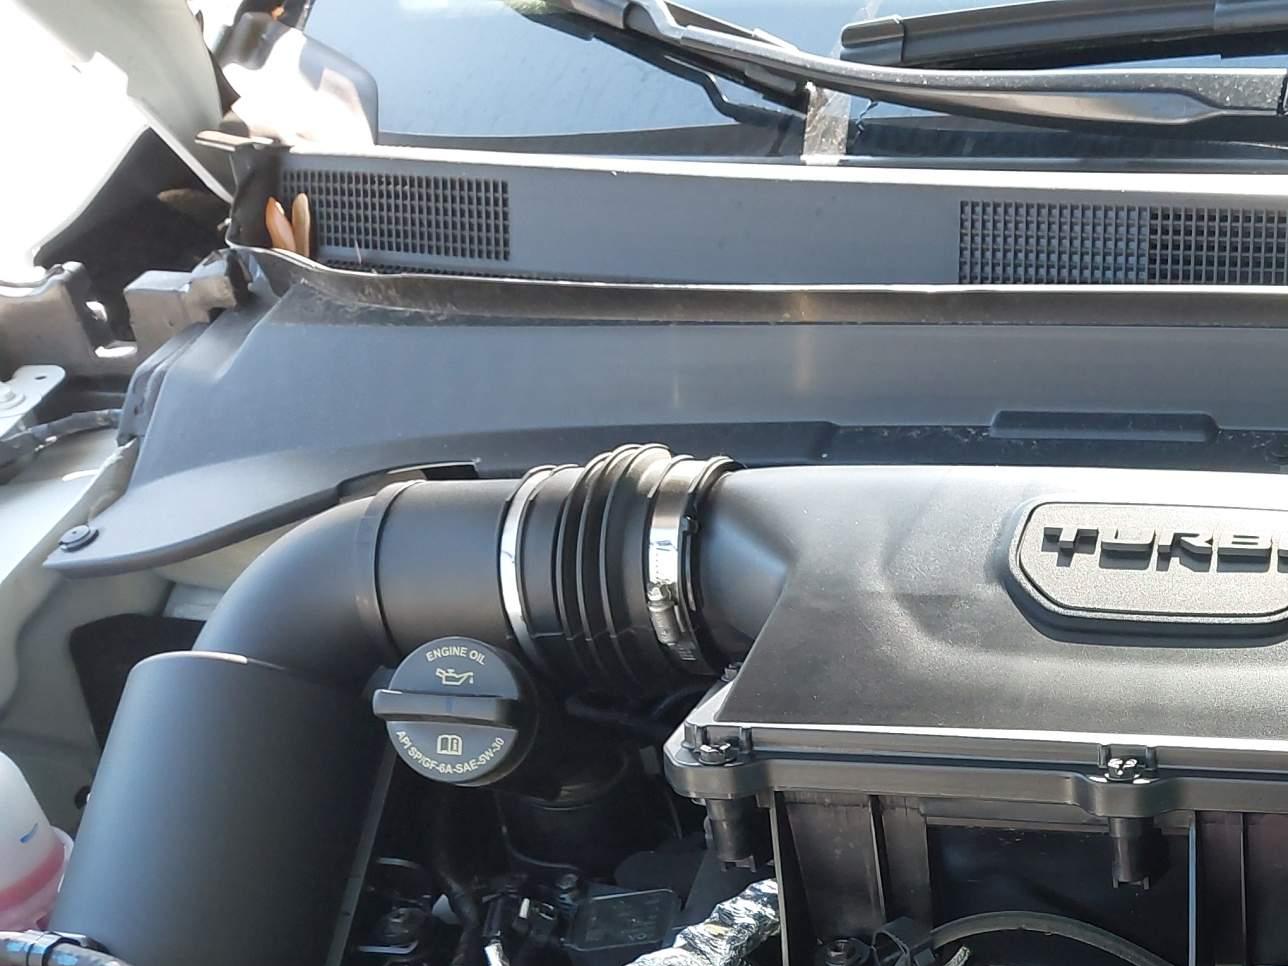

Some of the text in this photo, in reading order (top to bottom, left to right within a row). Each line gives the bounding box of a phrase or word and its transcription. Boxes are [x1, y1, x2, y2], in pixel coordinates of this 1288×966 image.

[425, 646, 487, 665] ENGINE OIL
[395, 730, 505, 774] API SP/GF-6A-SAE-5W-30
